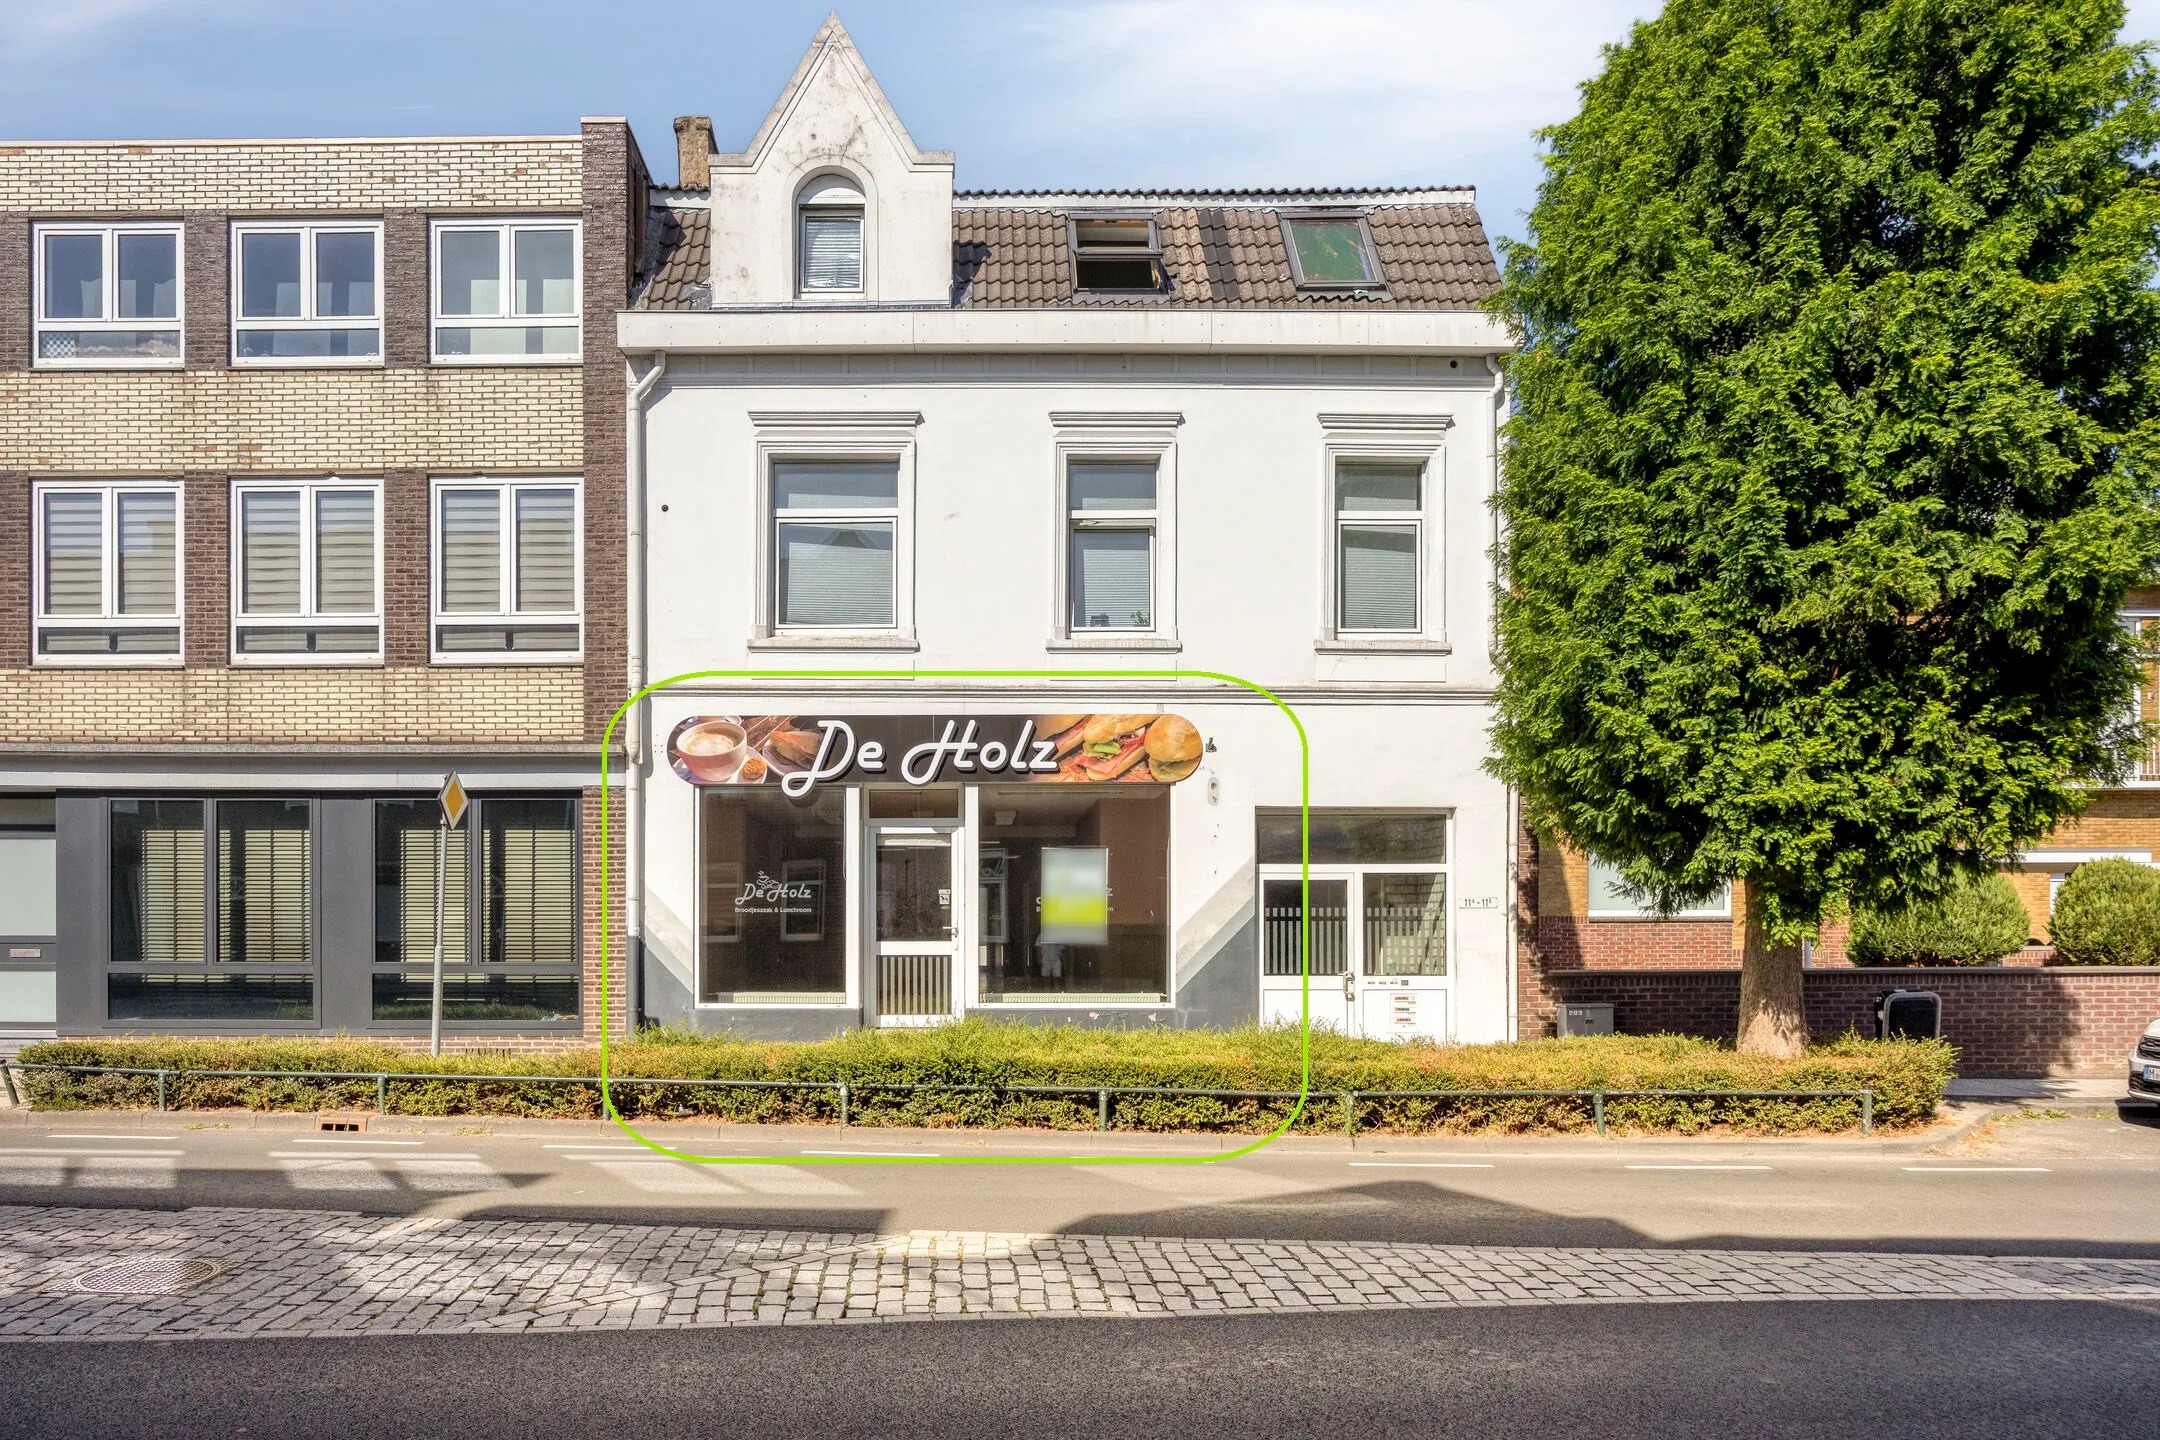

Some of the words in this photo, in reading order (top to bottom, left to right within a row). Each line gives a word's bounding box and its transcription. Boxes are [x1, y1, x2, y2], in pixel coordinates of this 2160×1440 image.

[781, 719, 885, 798] De
[900, 719, 1060, 786] Holz
[734, 883, 764, 905] De
[766, 883, 812, 902] Holz
